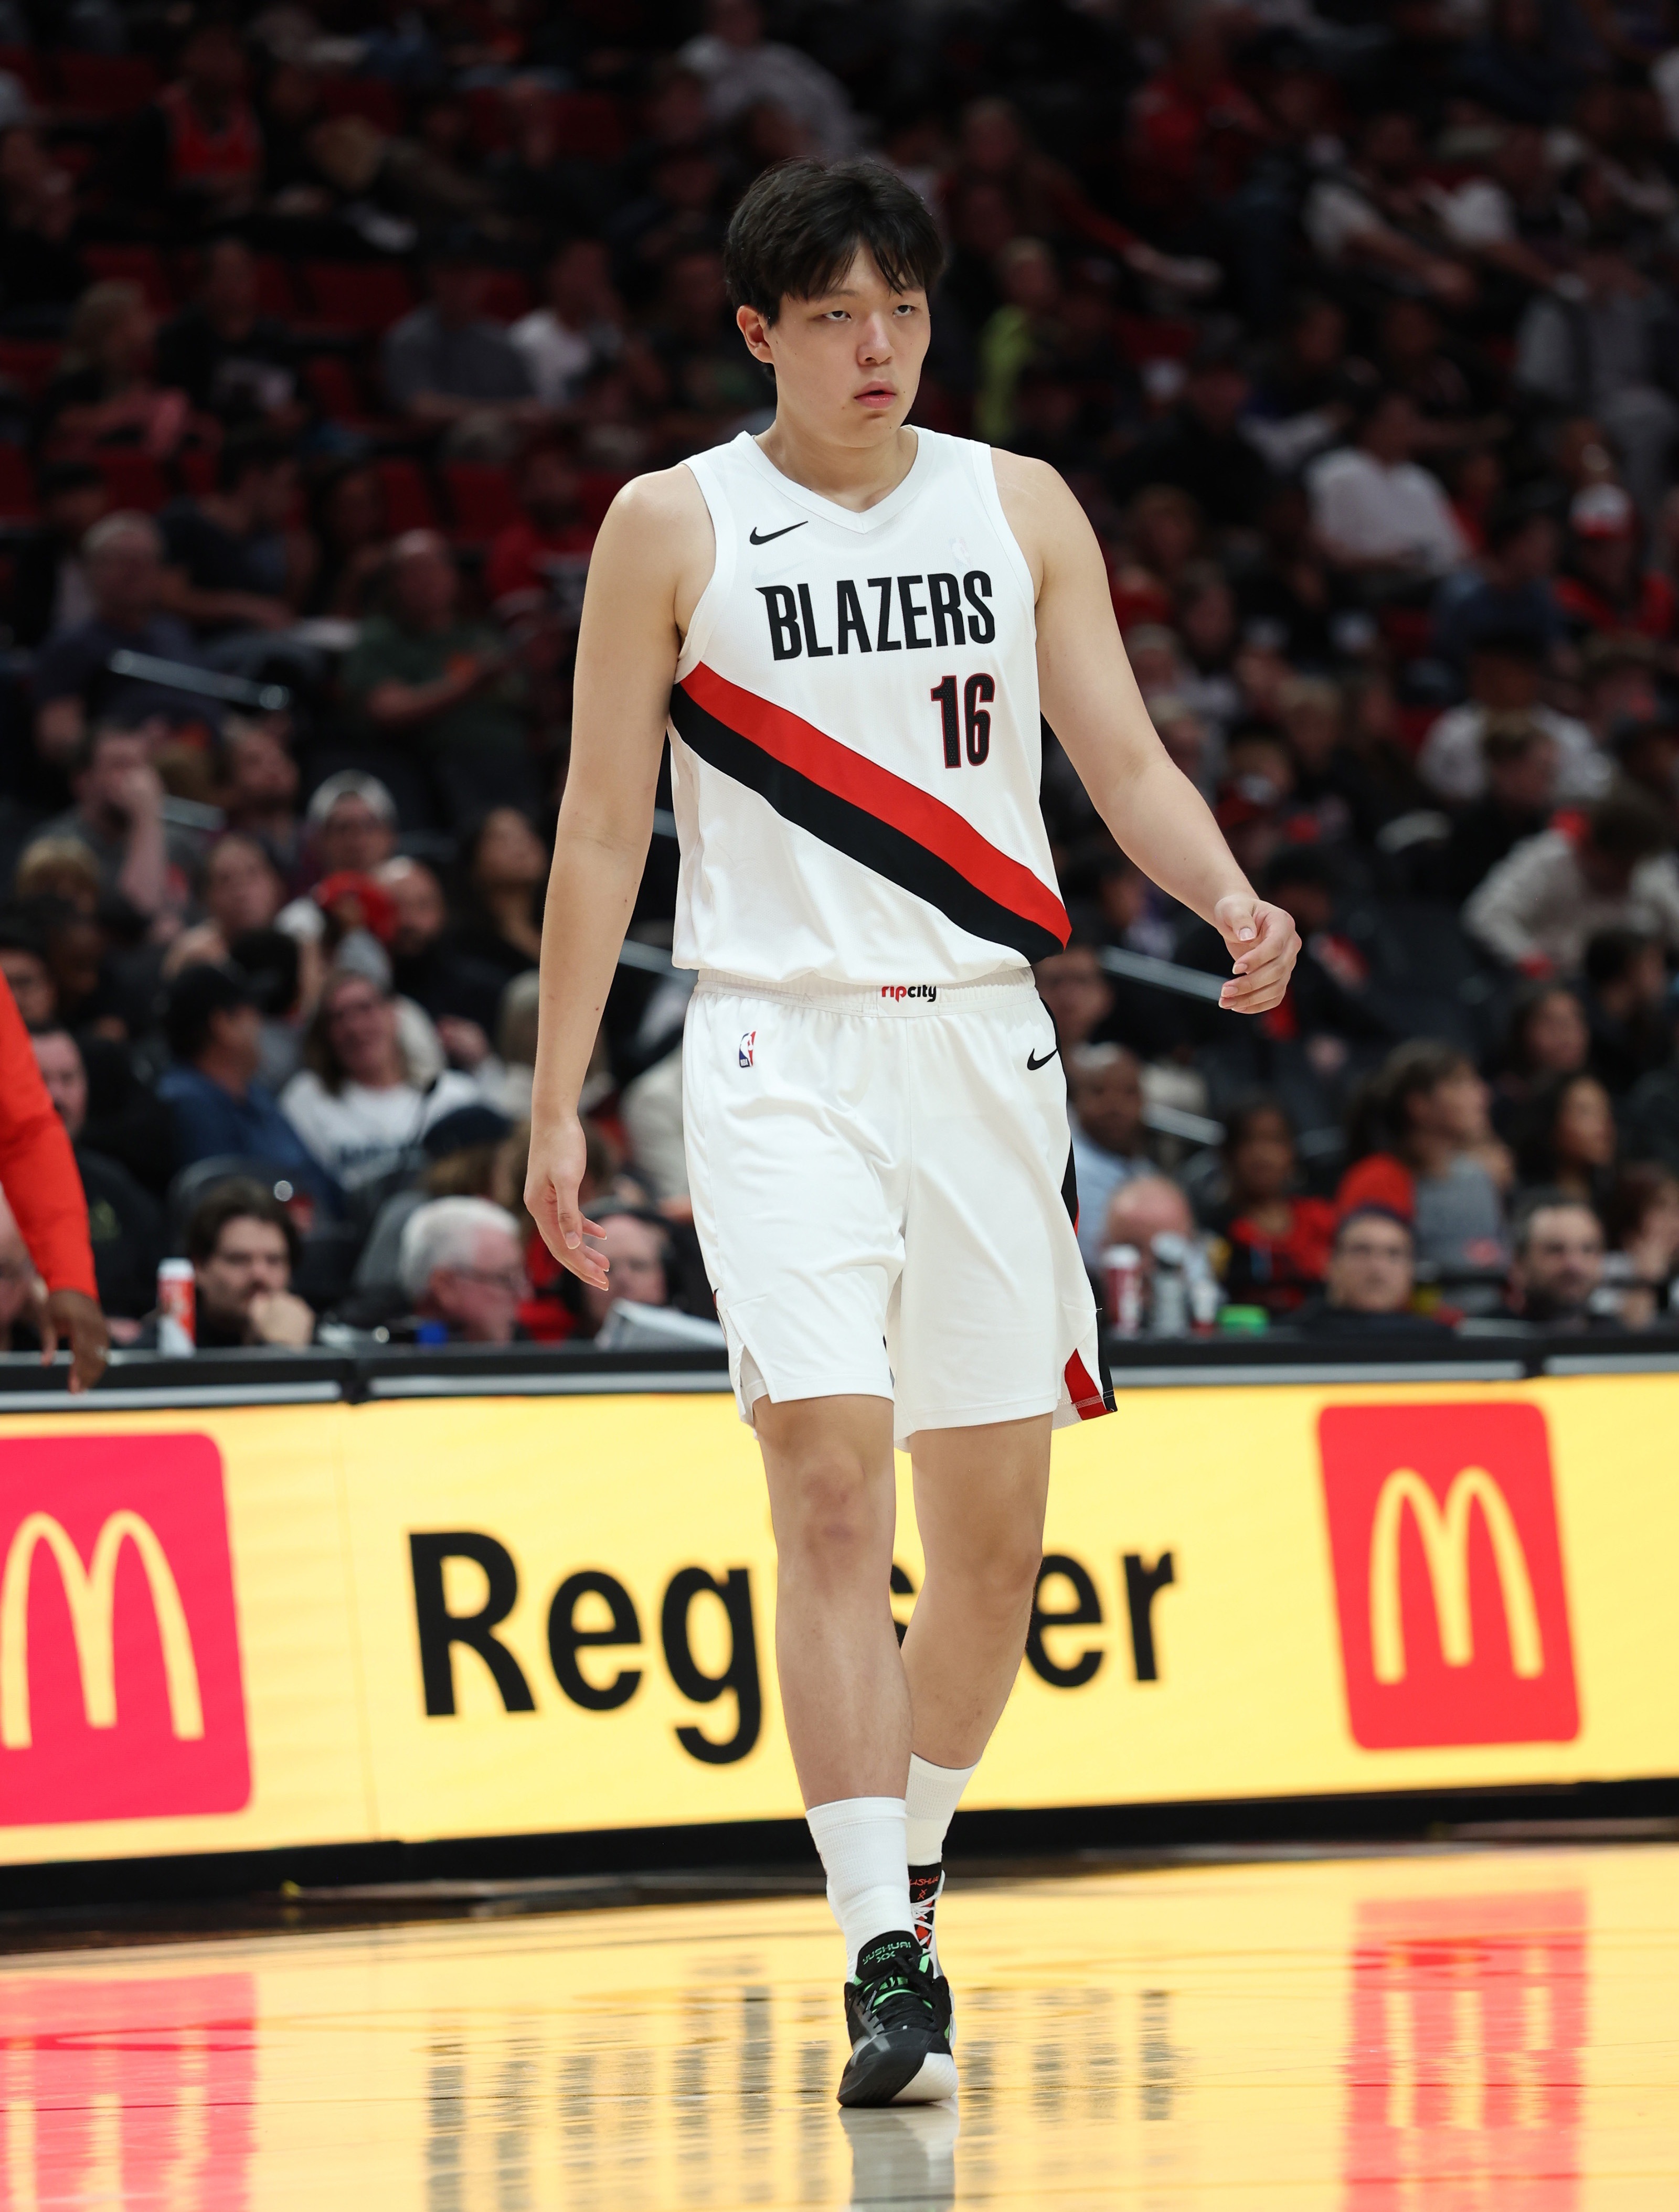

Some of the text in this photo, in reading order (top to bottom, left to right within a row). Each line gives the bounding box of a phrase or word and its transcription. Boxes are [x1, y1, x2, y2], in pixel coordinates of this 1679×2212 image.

[755, 570, 995, 660] BLAZERS
[931, 673, 995, 768] 16
[408, 1530, 1174, 1765] Reger
